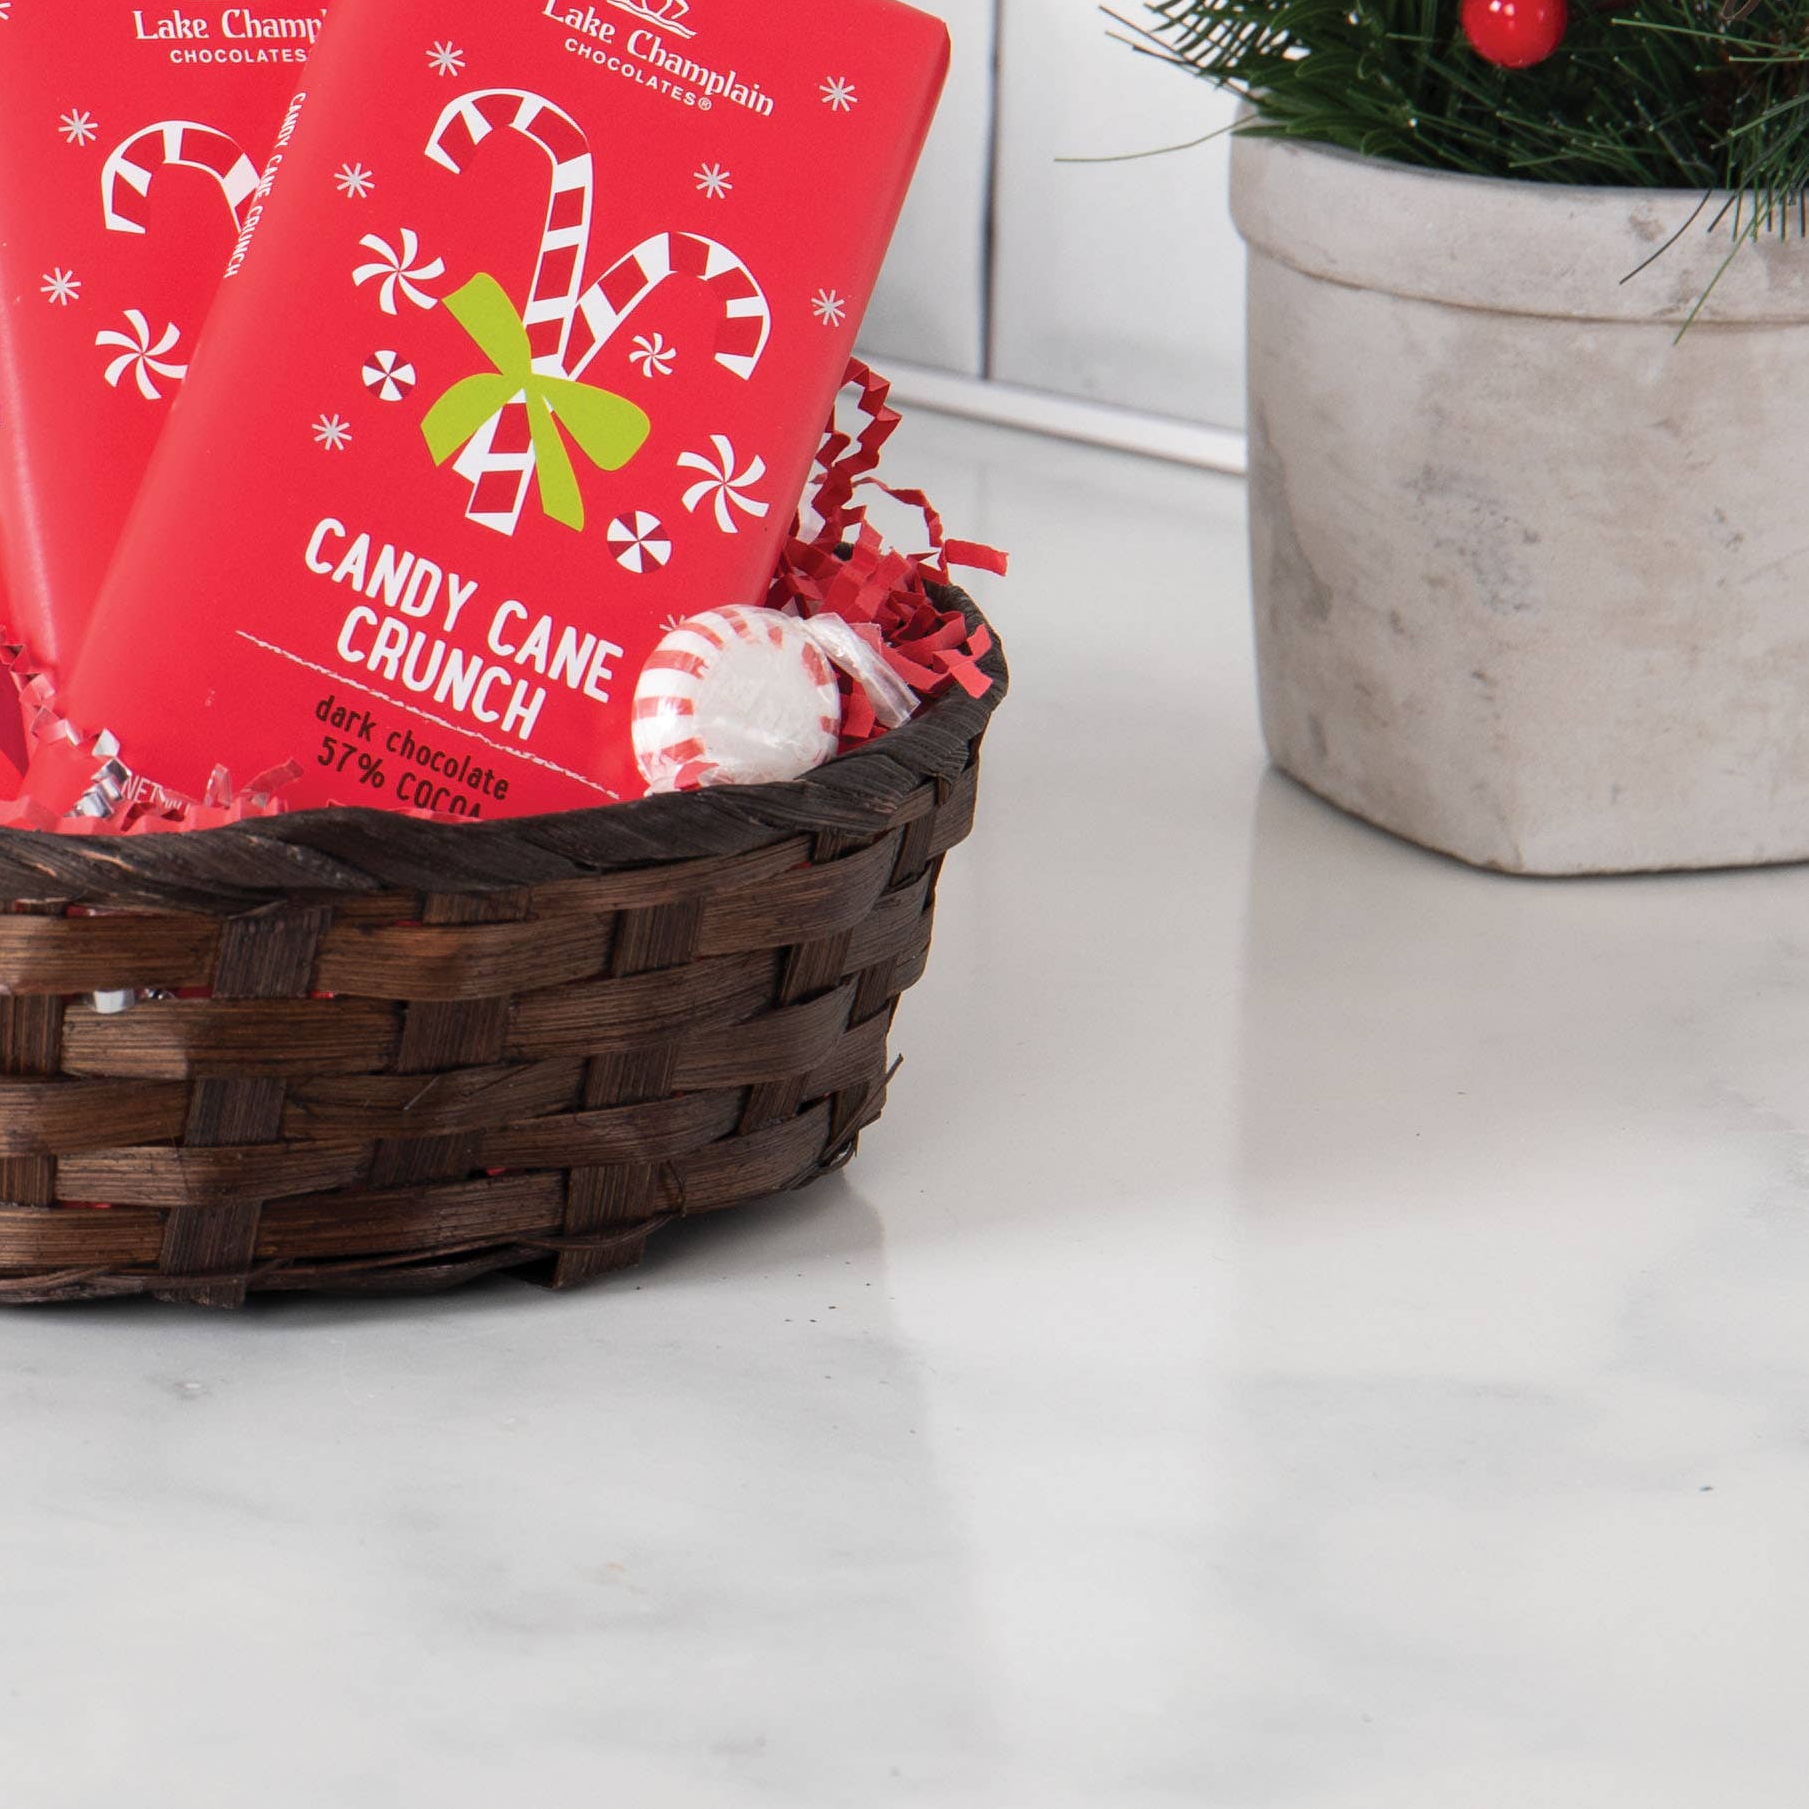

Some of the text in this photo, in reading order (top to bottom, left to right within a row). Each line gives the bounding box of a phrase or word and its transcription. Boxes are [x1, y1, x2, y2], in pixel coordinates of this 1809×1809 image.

[132, 8, 327, 44] Lake Champ
[627, 28, 774, 117] Champlain
[223, 92, 306, 279] CANDY CANE CRUNCH
[304, 517, 624, 704] CANDY CANE
[336, 606, 546, 741] CRUNCH
[315, 695, 509, 800] dark chocolate
[317, 736, 385, 788] 57%
